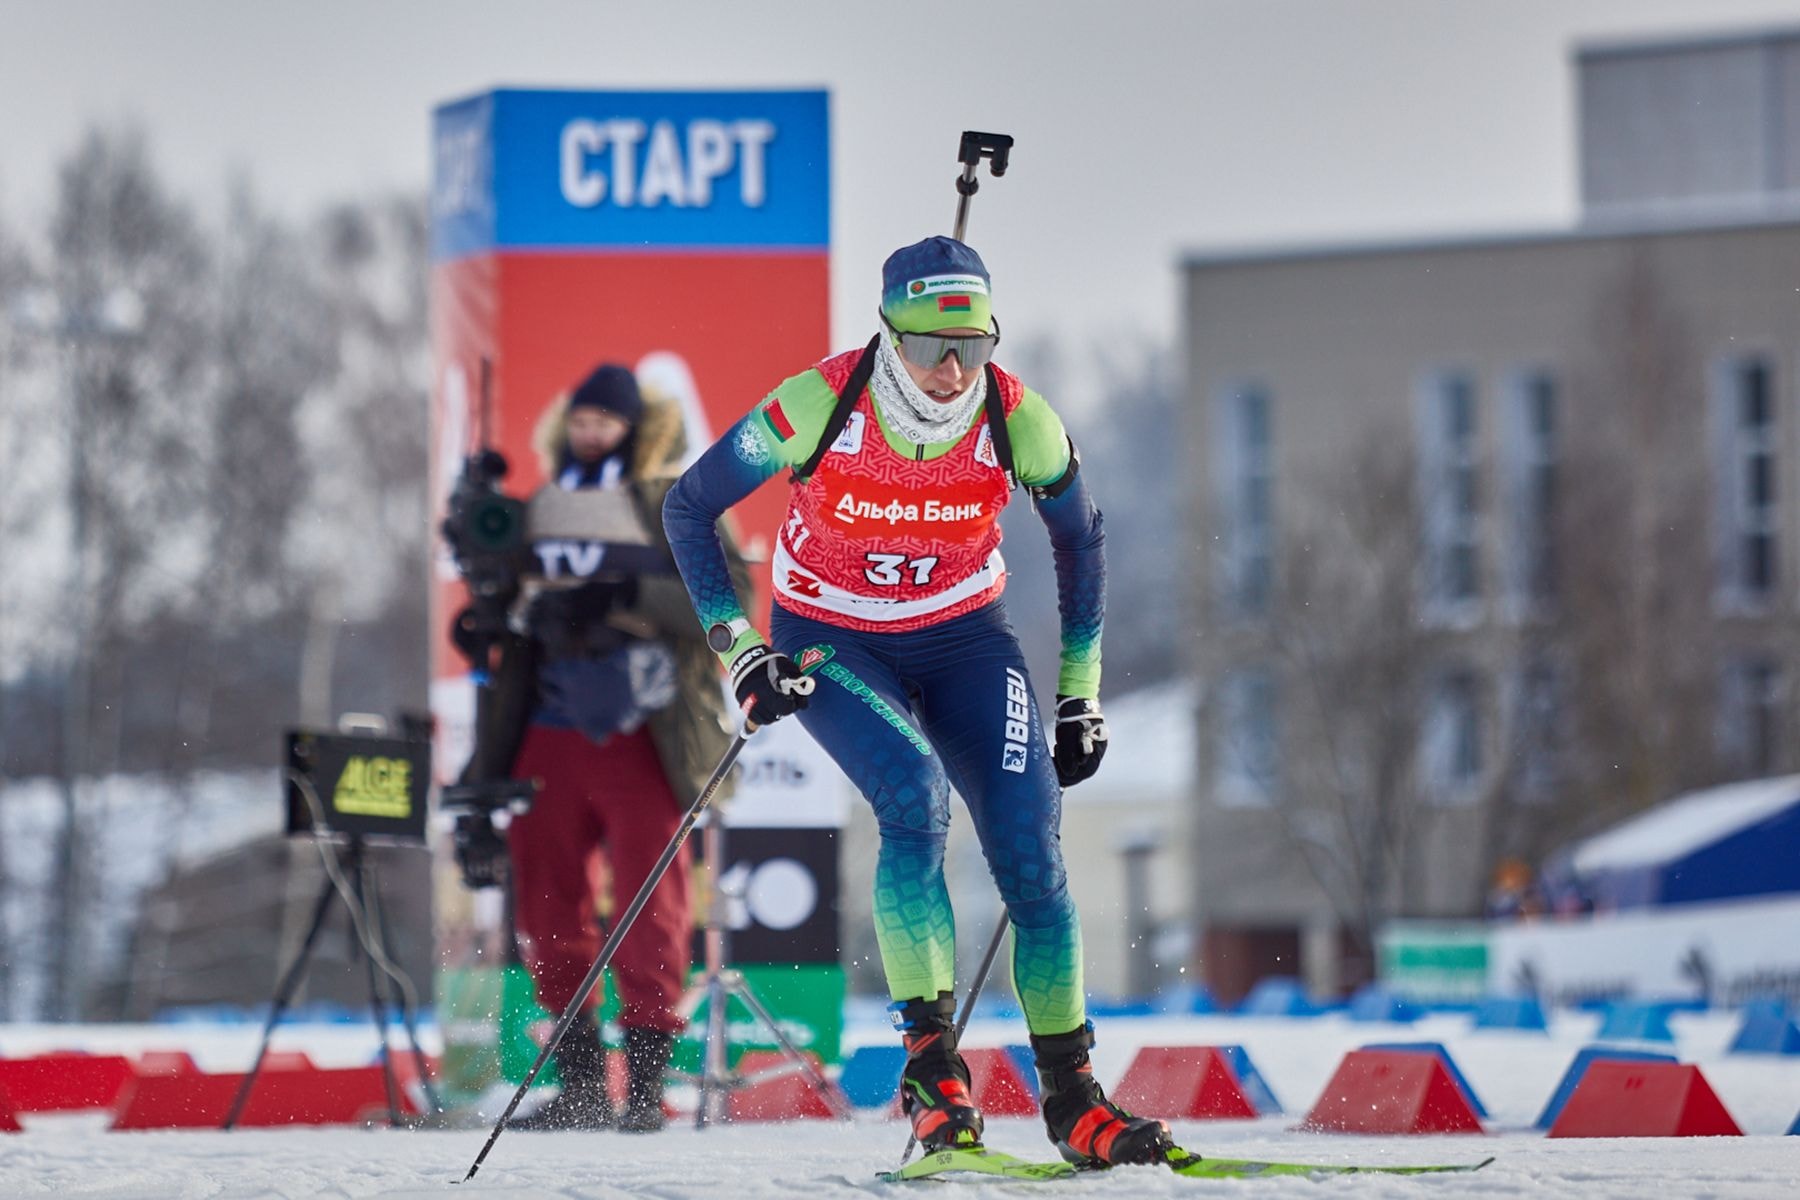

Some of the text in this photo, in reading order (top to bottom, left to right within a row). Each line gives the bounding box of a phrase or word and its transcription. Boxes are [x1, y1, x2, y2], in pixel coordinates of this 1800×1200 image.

[560, 118, 776, 208] СТАРТ
[834, 493, 983, 525] Альфа Банк
[864, 552, 939, 586] 31
